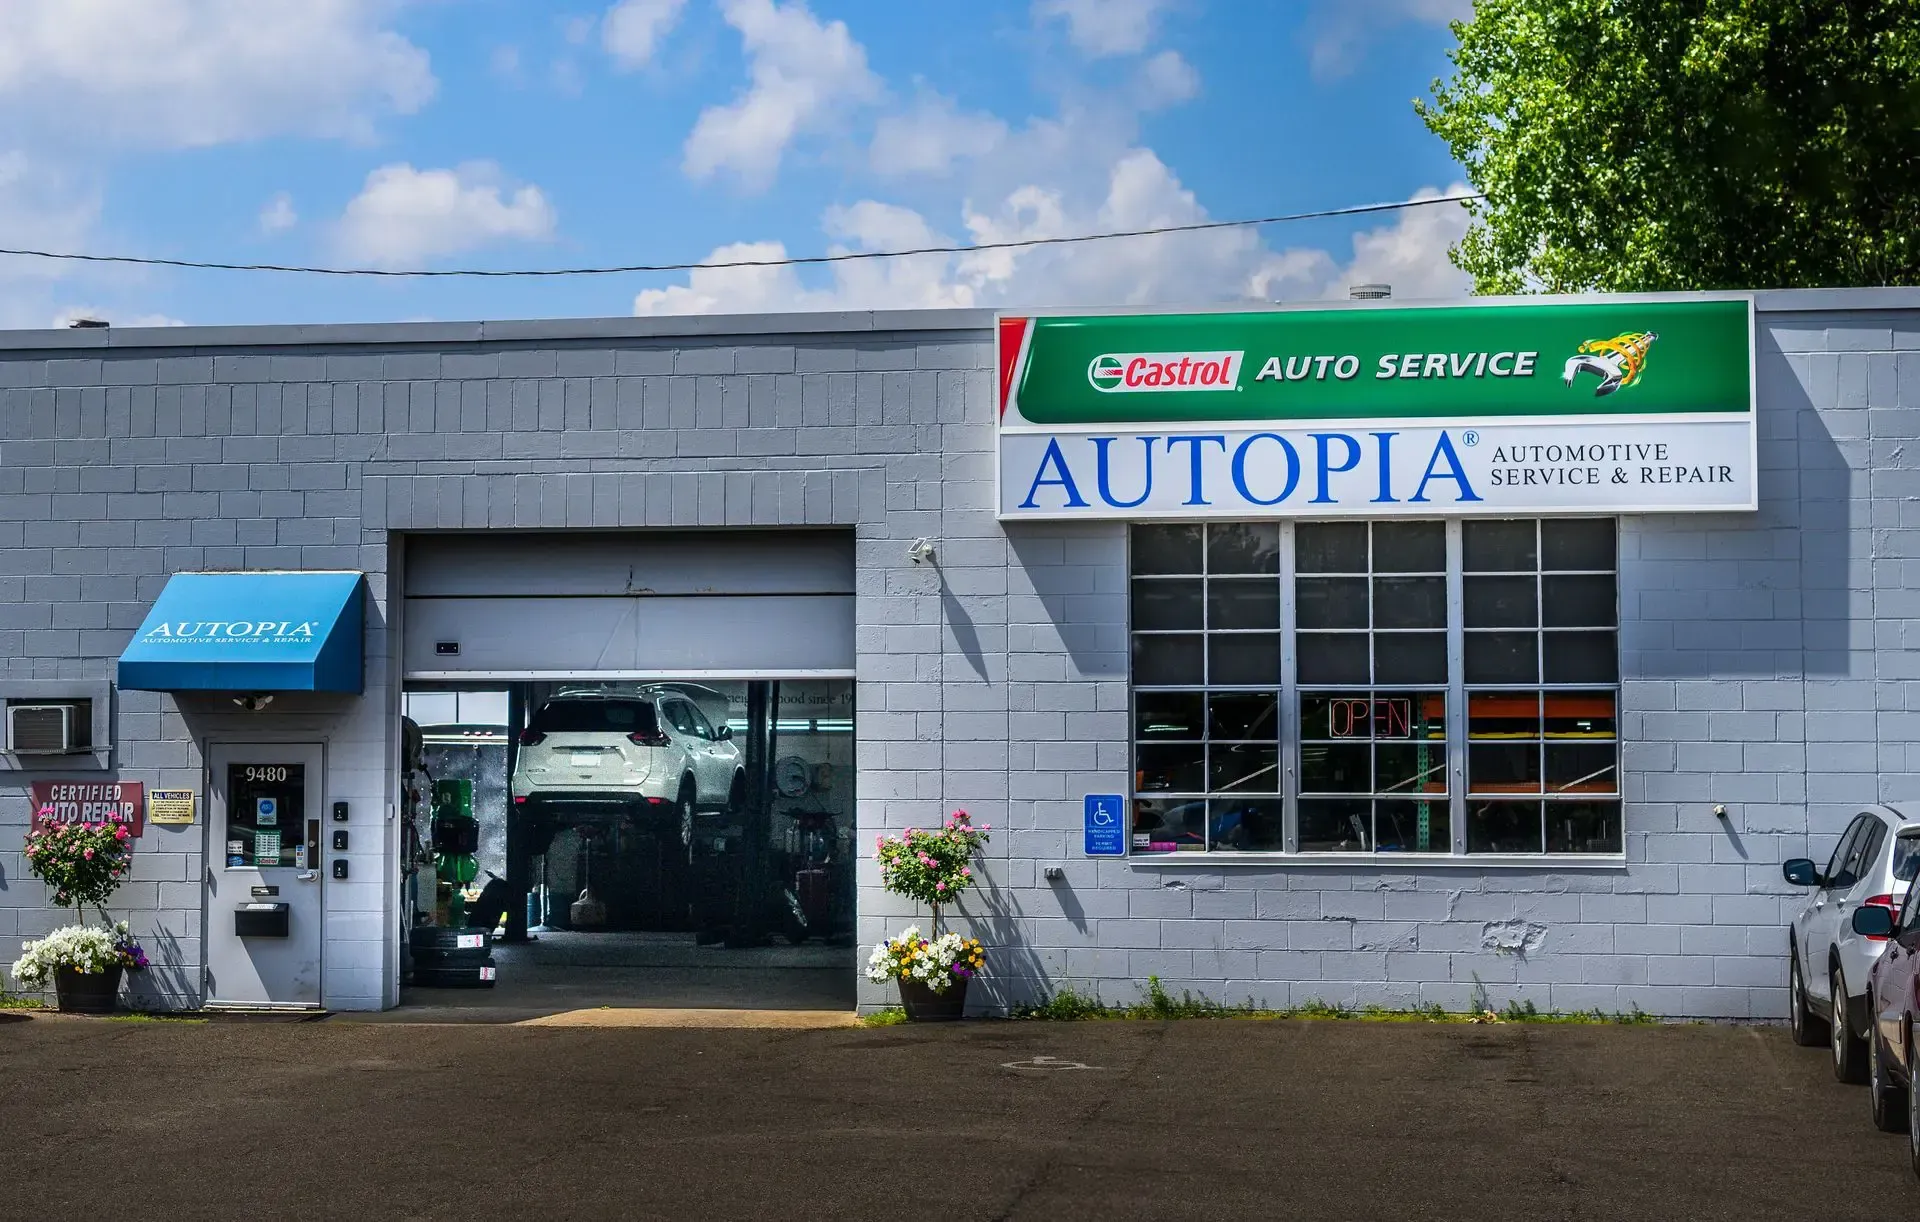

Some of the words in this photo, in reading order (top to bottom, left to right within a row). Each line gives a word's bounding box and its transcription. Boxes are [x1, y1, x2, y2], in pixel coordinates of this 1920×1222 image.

[1125, 356, 1232, 387] Castrol
[1255, 355, 1360, 381] AUTO
[1375, 351, 1538, 379] SERVICE
[1491, 443, 1669, 463] AUTOMOTIVE
[1491, 467, 1600, 486] SERVICE
[1610, 466, 1629, 485] &
[1639, 465, 1735, 484] REPAIR
[1332, 700, 1408, 736] OPEN
[246, 766, 287, 782] 9480
[51, 784, 122, 801] CERTIFIED
[153, 792, 164, 800] ALL
[164, 792, 190, 800] VEHICLES
[81, 802, 134, 823] REPAIR
